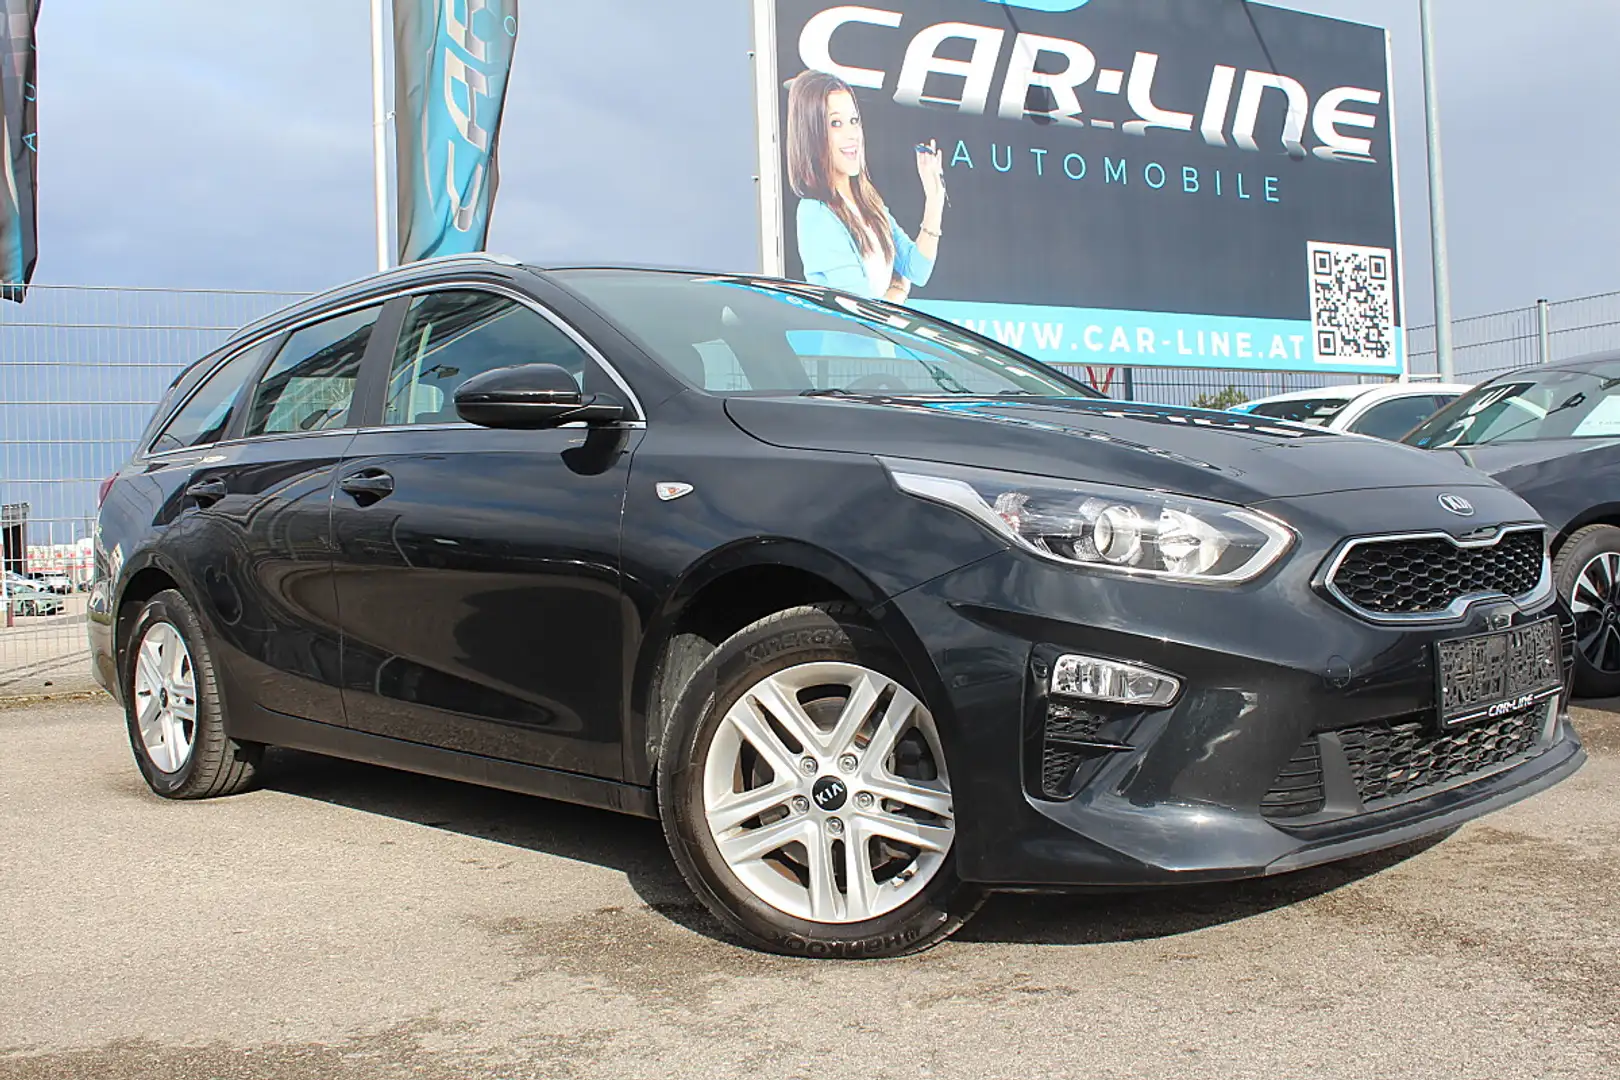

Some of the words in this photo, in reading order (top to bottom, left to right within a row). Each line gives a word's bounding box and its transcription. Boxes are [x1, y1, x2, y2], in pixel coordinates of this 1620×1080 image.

[797, 5, 1382, 158] CAR-LINE
[950, 140, 1281, 203] AUTOMOBILE
[1488, 694, 1534, 717] CAR-LINE
[815, 783, 844, 805] KIA
